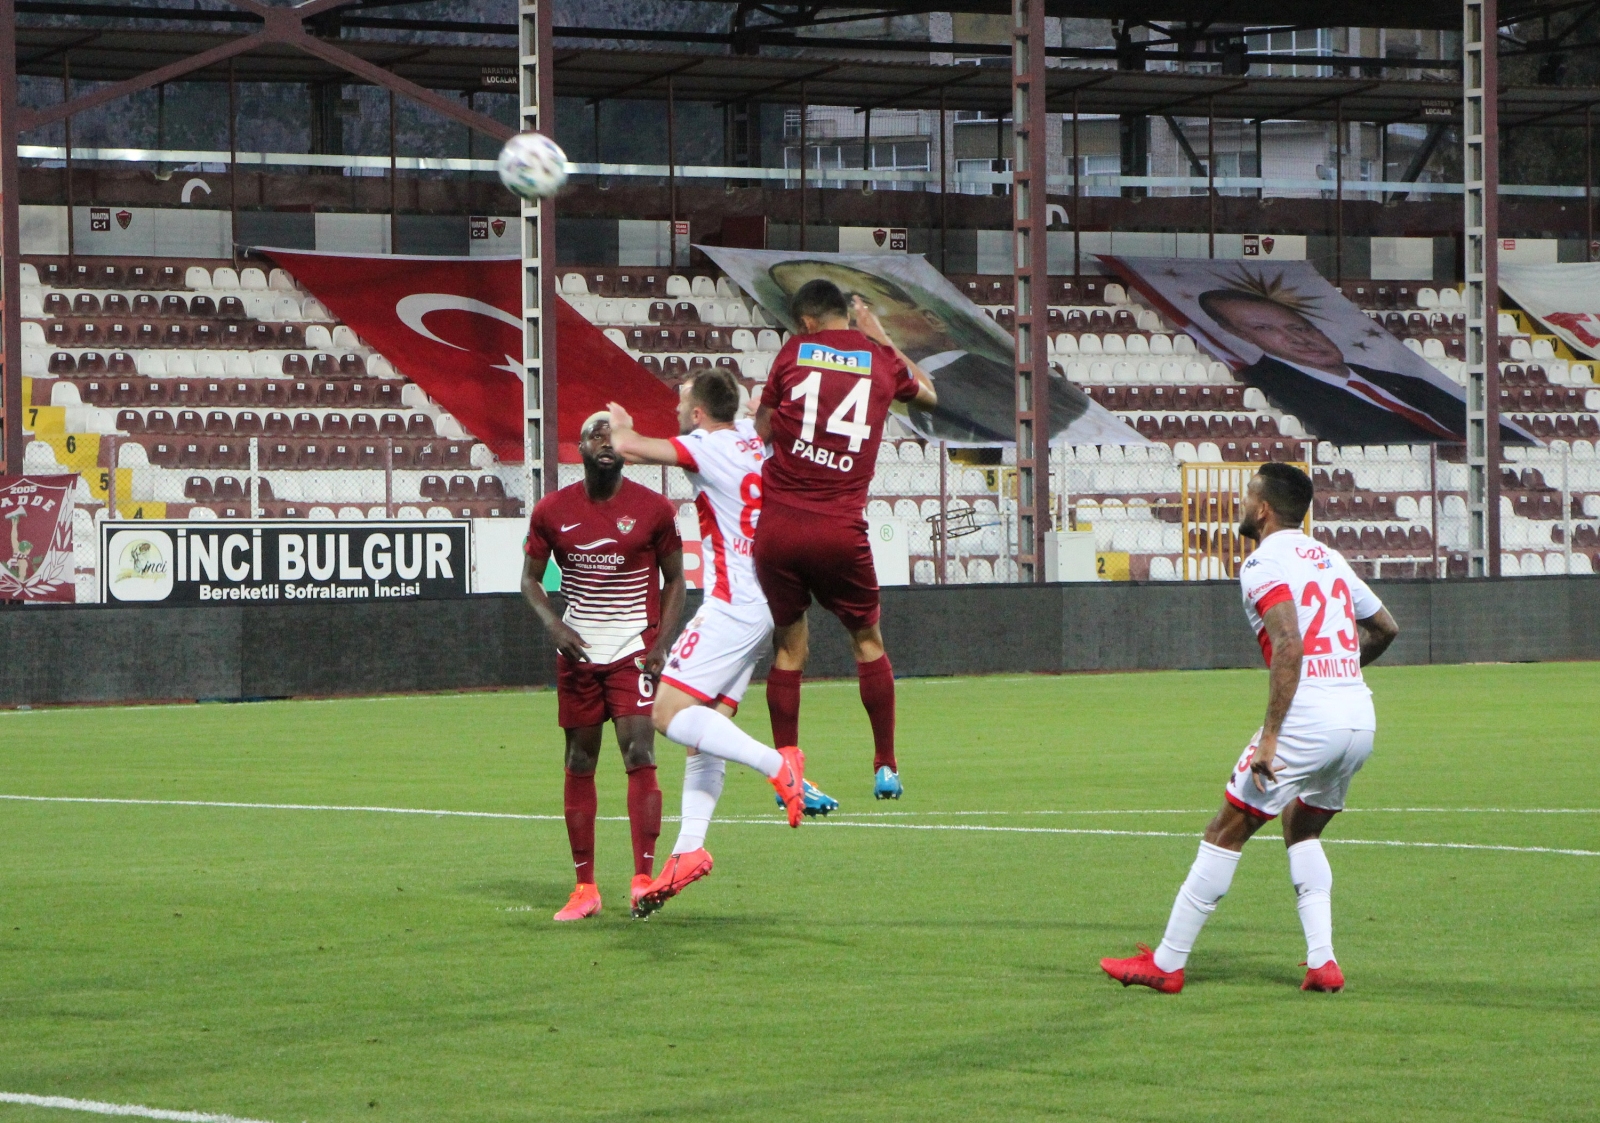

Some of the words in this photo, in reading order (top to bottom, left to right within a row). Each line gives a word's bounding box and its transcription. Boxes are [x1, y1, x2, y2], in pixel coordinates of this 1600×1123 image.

[486, 76, 517, 84] LOCALAR
[93, 221, 107, 229] C-1
[472, 229, 486, 237] C-2
[891, 240, 904, 248] C-3
[811, 349, 858, 367] aksa
[28, 408, 38, 427] 7
[791, 371, 872, 453] 14
[66, 435, 76, 453] 6
[791, 438, 854, 473] PABLO
[100, 473, 109, 491] 5
[986, 470, 995, 486] 5
[10, 485, 37, 494] 2005
[279, 533, 454, 581] BULGUR
[567, 552, 625, 565] concorde
[1097, 557, 1106, 573] 2
[200, 584, 279, 600] Bereketli
[284, 583, 369, 599] Sofraların
[1301, 577, 1358, 656] 23
[638, 673, 654, 698] 6
